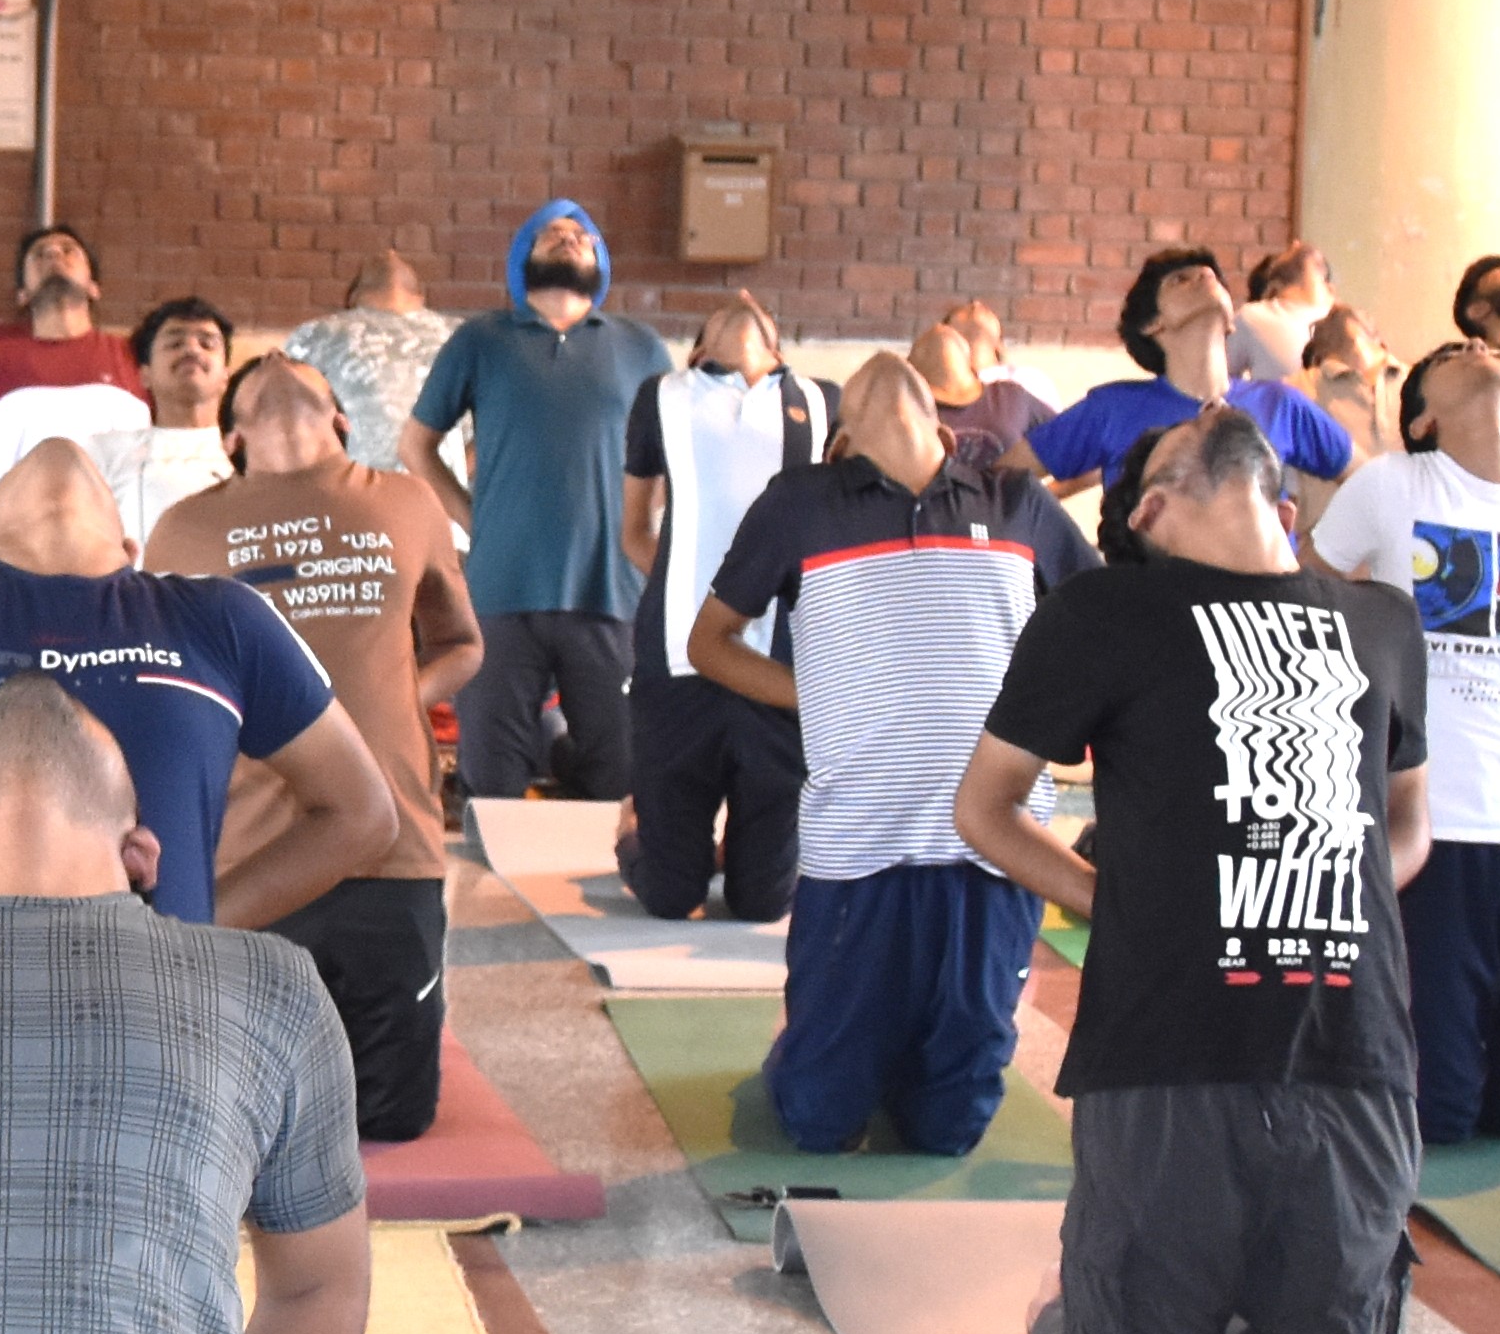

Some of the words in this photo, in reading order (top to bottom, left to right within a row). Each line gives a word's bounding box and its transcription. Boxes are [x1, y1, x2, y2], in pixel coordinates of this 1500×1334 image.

[227, 525, 267, 544] CKJ
[272, 517, 319, 537] NYC
[228, 546, 266, 567] EST.
[273, 538, 323, 558] 1978
[297, 554, 397, 578] ORIGINAL
[282, 583, 356, 607] W39TH
[361, 581, 385, 601] ST.
[40, 643, 182, 674] Dynamics
[1217, 835, 1370, 933] WHEEL
[1217, 957, 1247, 968] GEAR
